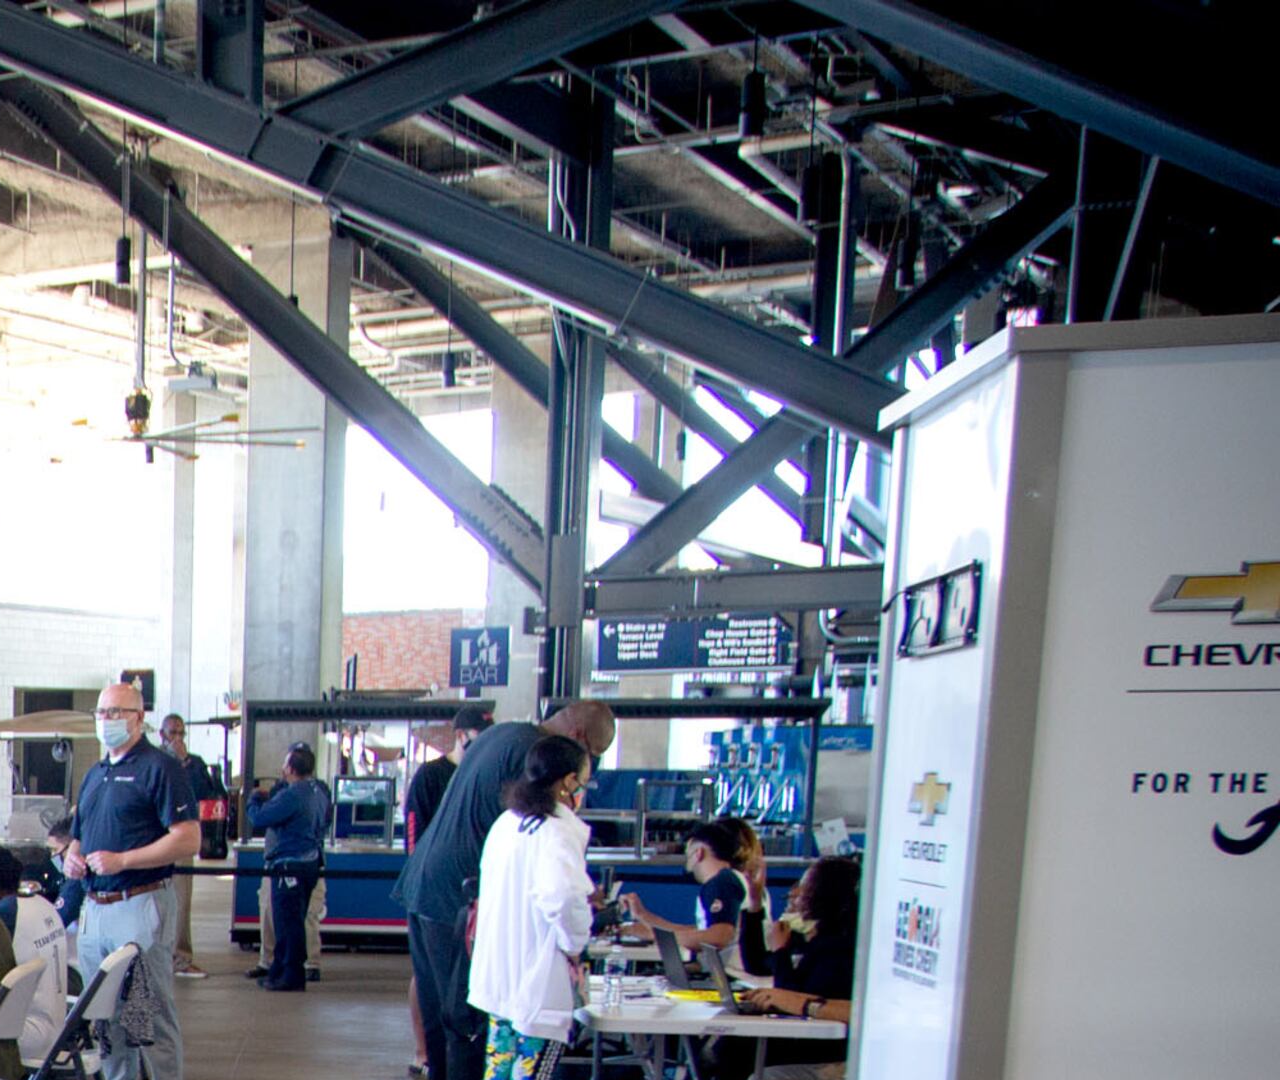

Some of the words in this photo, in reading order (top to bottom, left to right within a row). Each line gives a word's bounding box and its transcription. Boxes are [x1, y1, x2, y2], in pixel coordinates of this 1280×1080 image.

[640, 641, 658, 650] Level
[460, 666, 497, 684] BAR
[1132, 773, 1191, 794] FOR
[1209, 773, 1269, 794] THE
